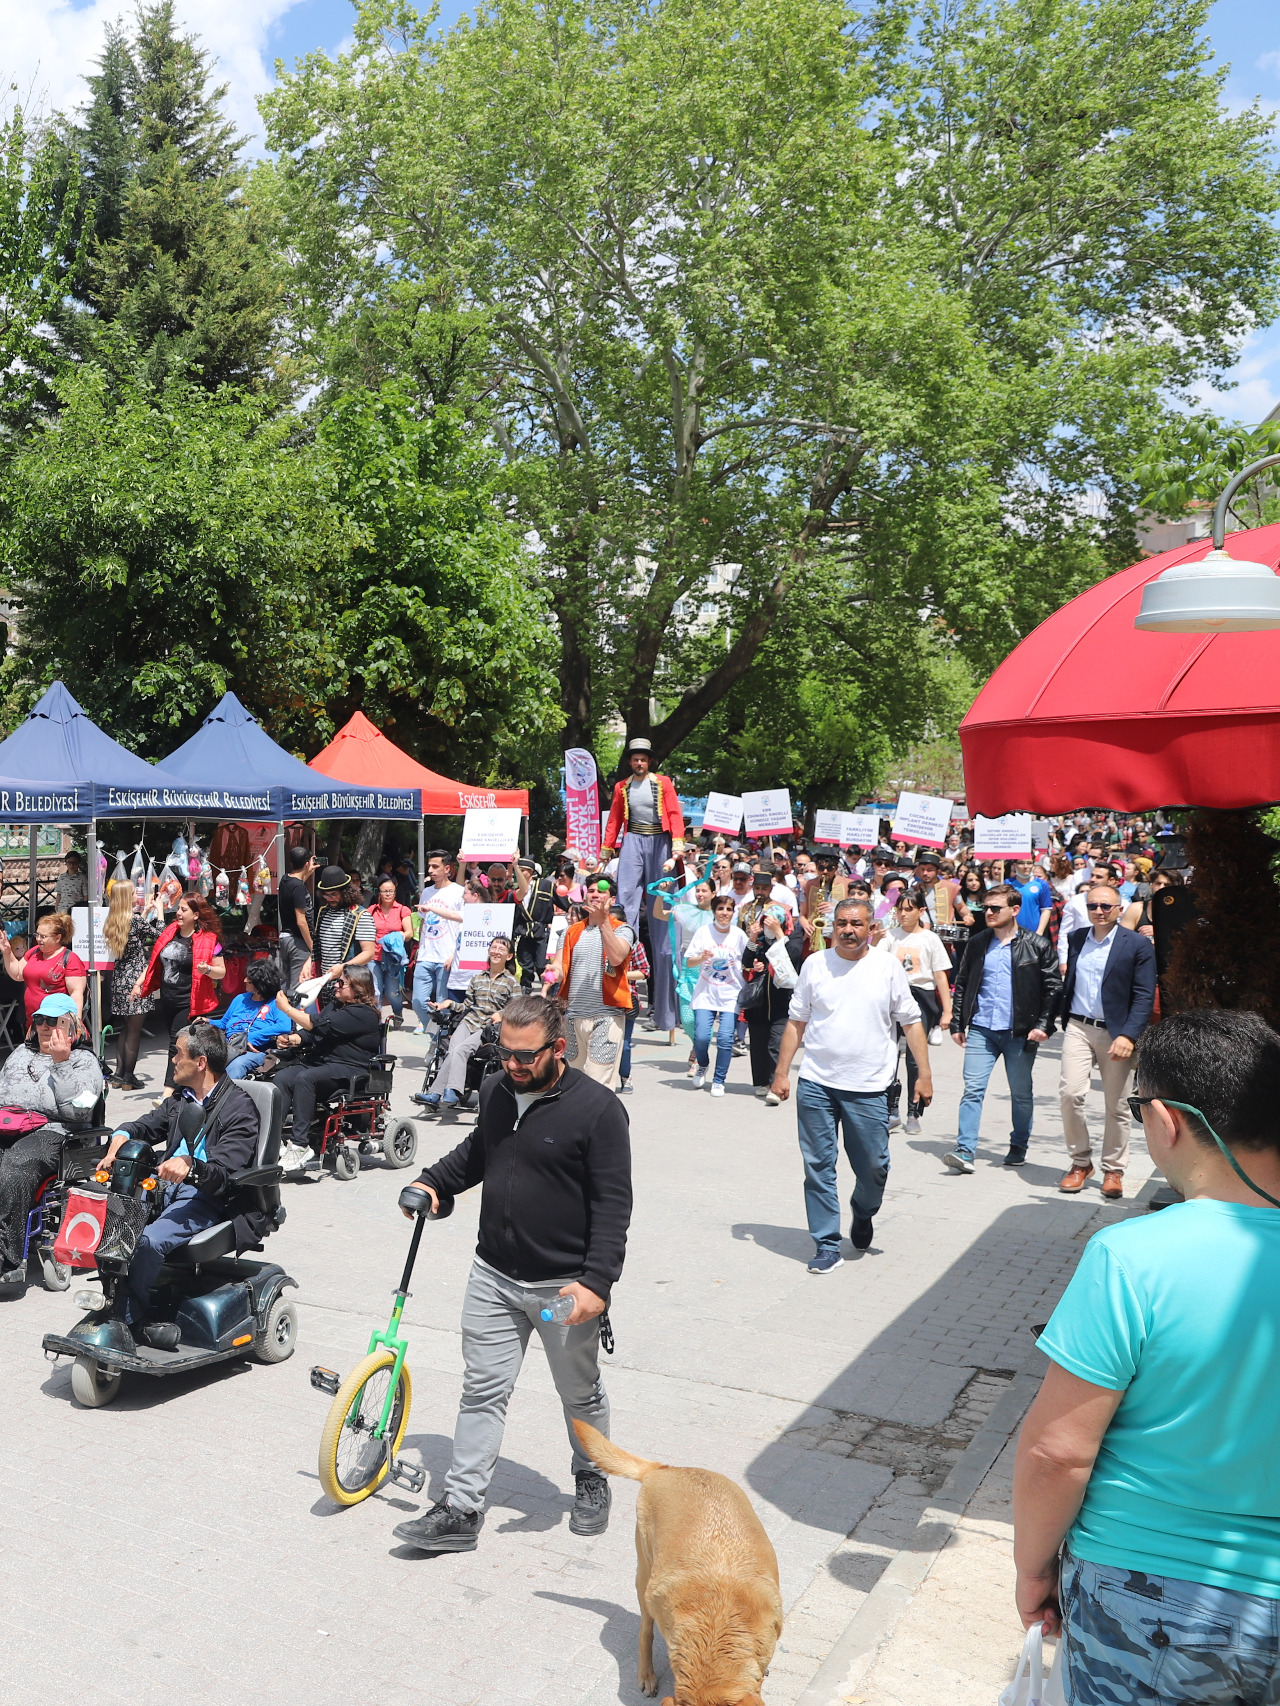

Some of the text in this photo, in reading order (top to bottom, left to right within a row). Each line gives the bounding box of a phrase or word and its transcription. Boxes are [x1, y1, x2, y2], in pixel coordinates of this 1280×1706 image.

[15, 788, 79, 812] BELEDİYESİ
[108, 787, 271, 811] ESKİŞEHİR BÜYÜKŞEHİR BELEDİYESİ
[291, 792, 414, 813] ESKİŞEHİR BÜYÜKŞEHİR BELEDİYESİ
[463, 930, 486, 938] ENGEL
